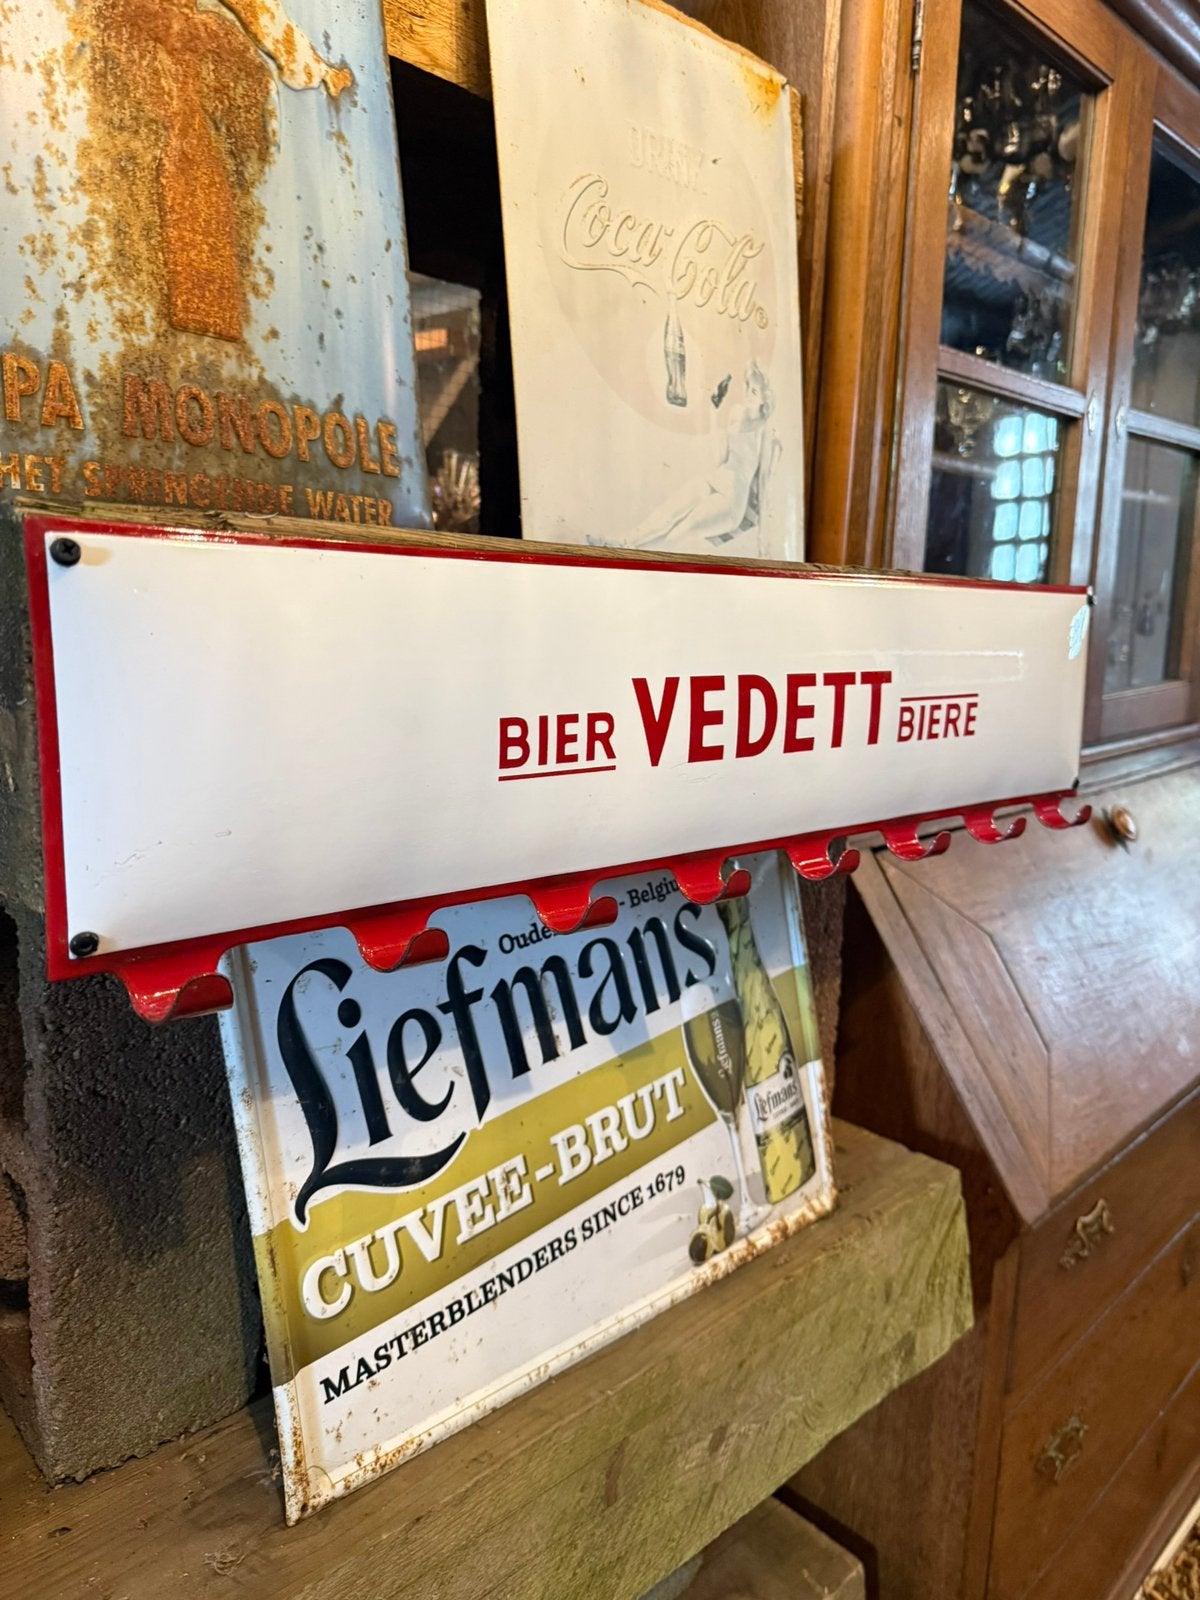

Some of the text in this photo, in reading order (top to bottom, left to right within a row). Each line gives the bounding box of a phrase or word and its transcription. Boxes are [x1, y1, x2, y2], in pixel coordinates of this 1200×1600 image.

[2, 352, 400, 477] PA MONOPOLE
[305, 488, 393, 526] WATER
[498, 670, 979, 770] BIER VEDETT BIERE
[498, 922, 559, 955] Oude
[626, 876, 680, 908] Belgiu
[276, 902, 717, 1227] Liefmans
[319, 1164, 687, 1405] MASTERBLENDERS SINCE 1679
